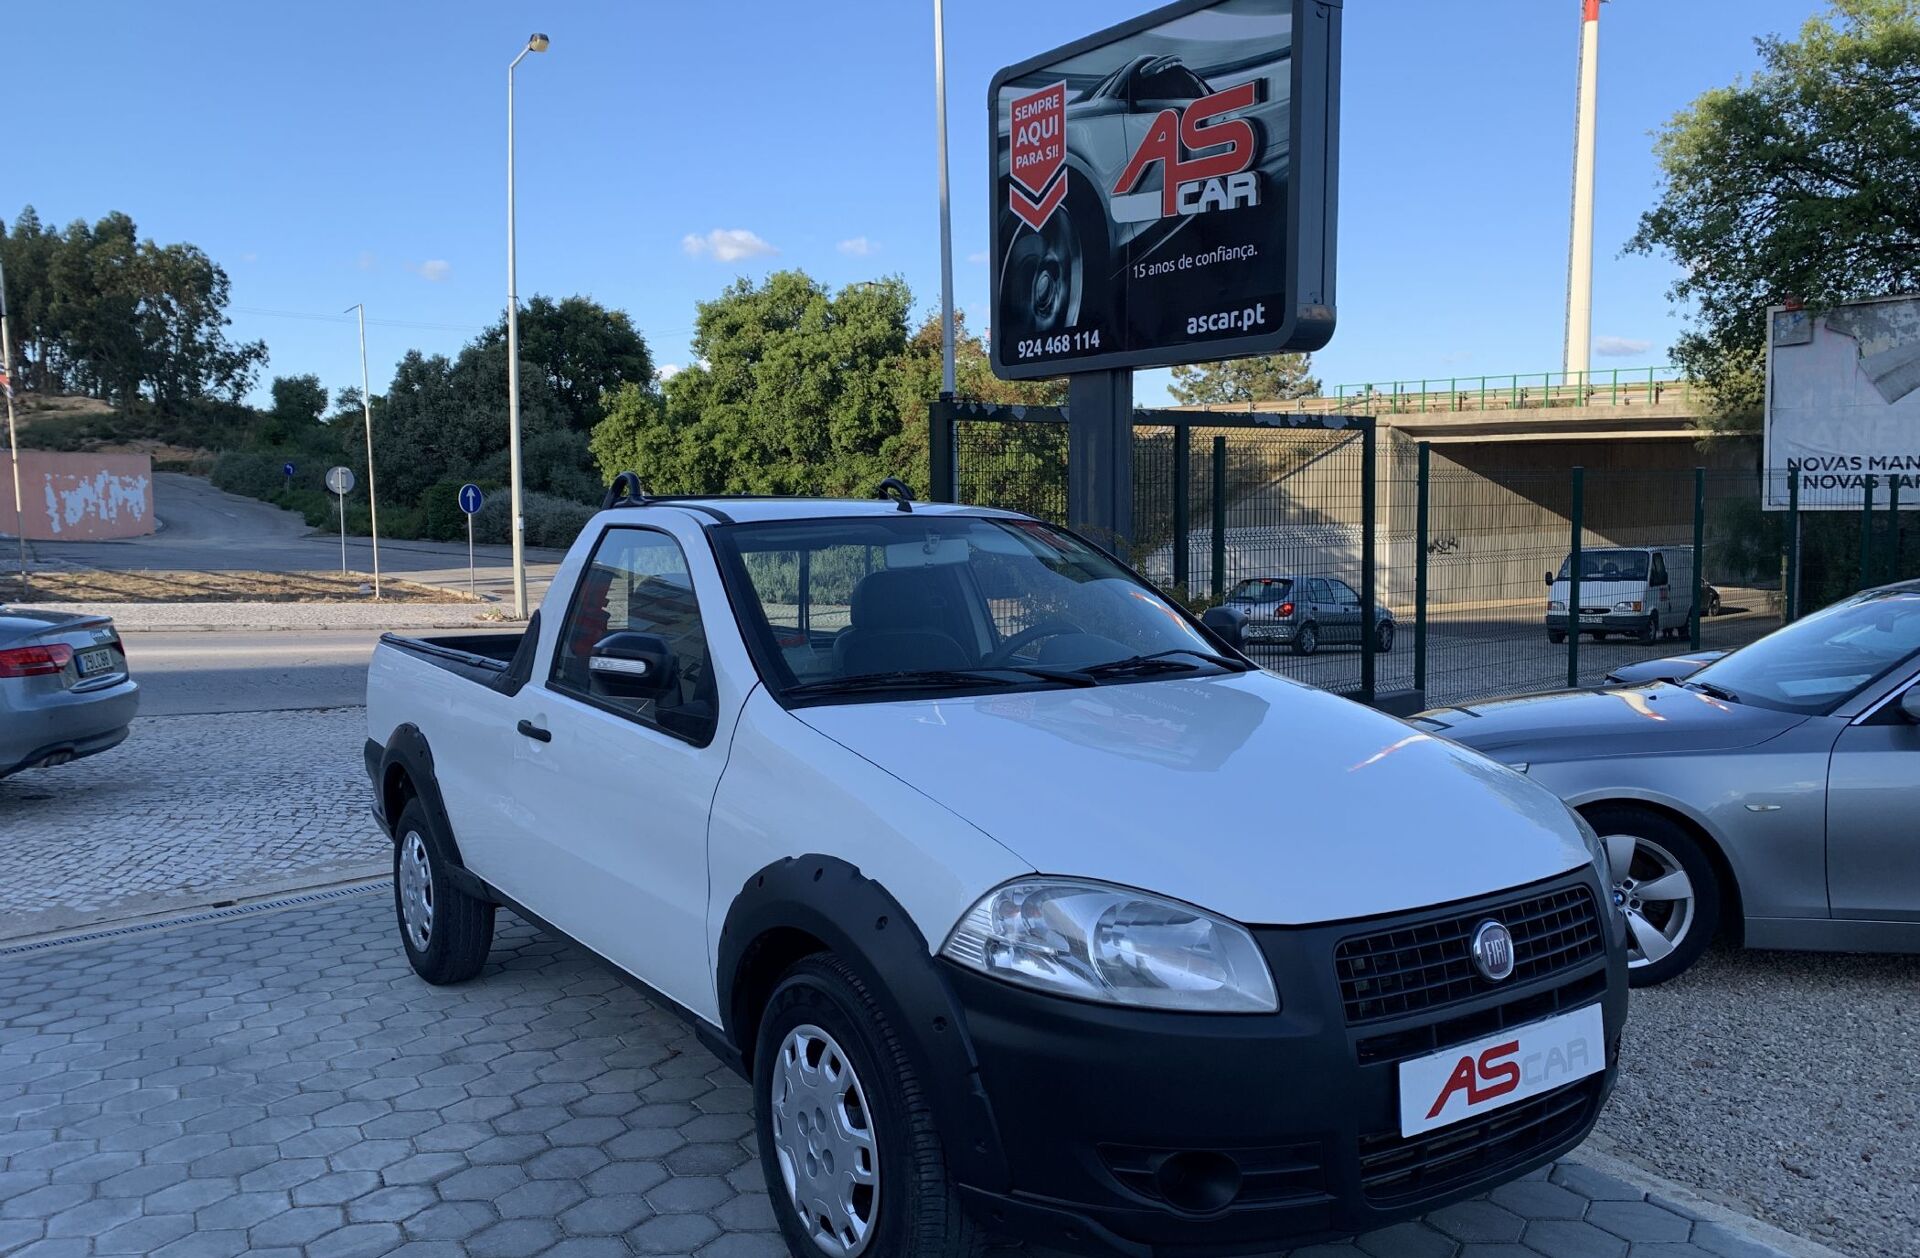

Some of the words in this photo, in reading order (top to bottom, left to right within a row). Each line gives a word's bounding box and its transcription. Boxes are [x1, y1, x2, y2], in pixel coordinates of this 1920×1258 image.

[1015, 93, 1060, 121] SEMPRE
[1016, 114, 1059, 148] AQUI
[1016, 150, 1044, 169] PARA
[1046, 144, 1059, 160] SI!
[1111, 81, 1256, 217] AS
[1177, 170, 1261, 216] CAR
[1133, 263, 1146, 279] 15
[1148, 260, 1175, 276] anos
[1178, 253, 1193, 270] de
[1195, 244, 1258, 266] confiança.
[1186, 302, 1266, 335] ascar.pt
[1018, 338, 1043, 359] 924
[1045, 334, 1071, 354] 468
[1074, 329, 1101, 351] 114
[1787, 456, 1863, 472] NOVAS
[1869, 455, 1920, 471] MAN
[1803, 473, 1880, 489] NOVAS
[1484, 937, 1508, 967] FIAT
